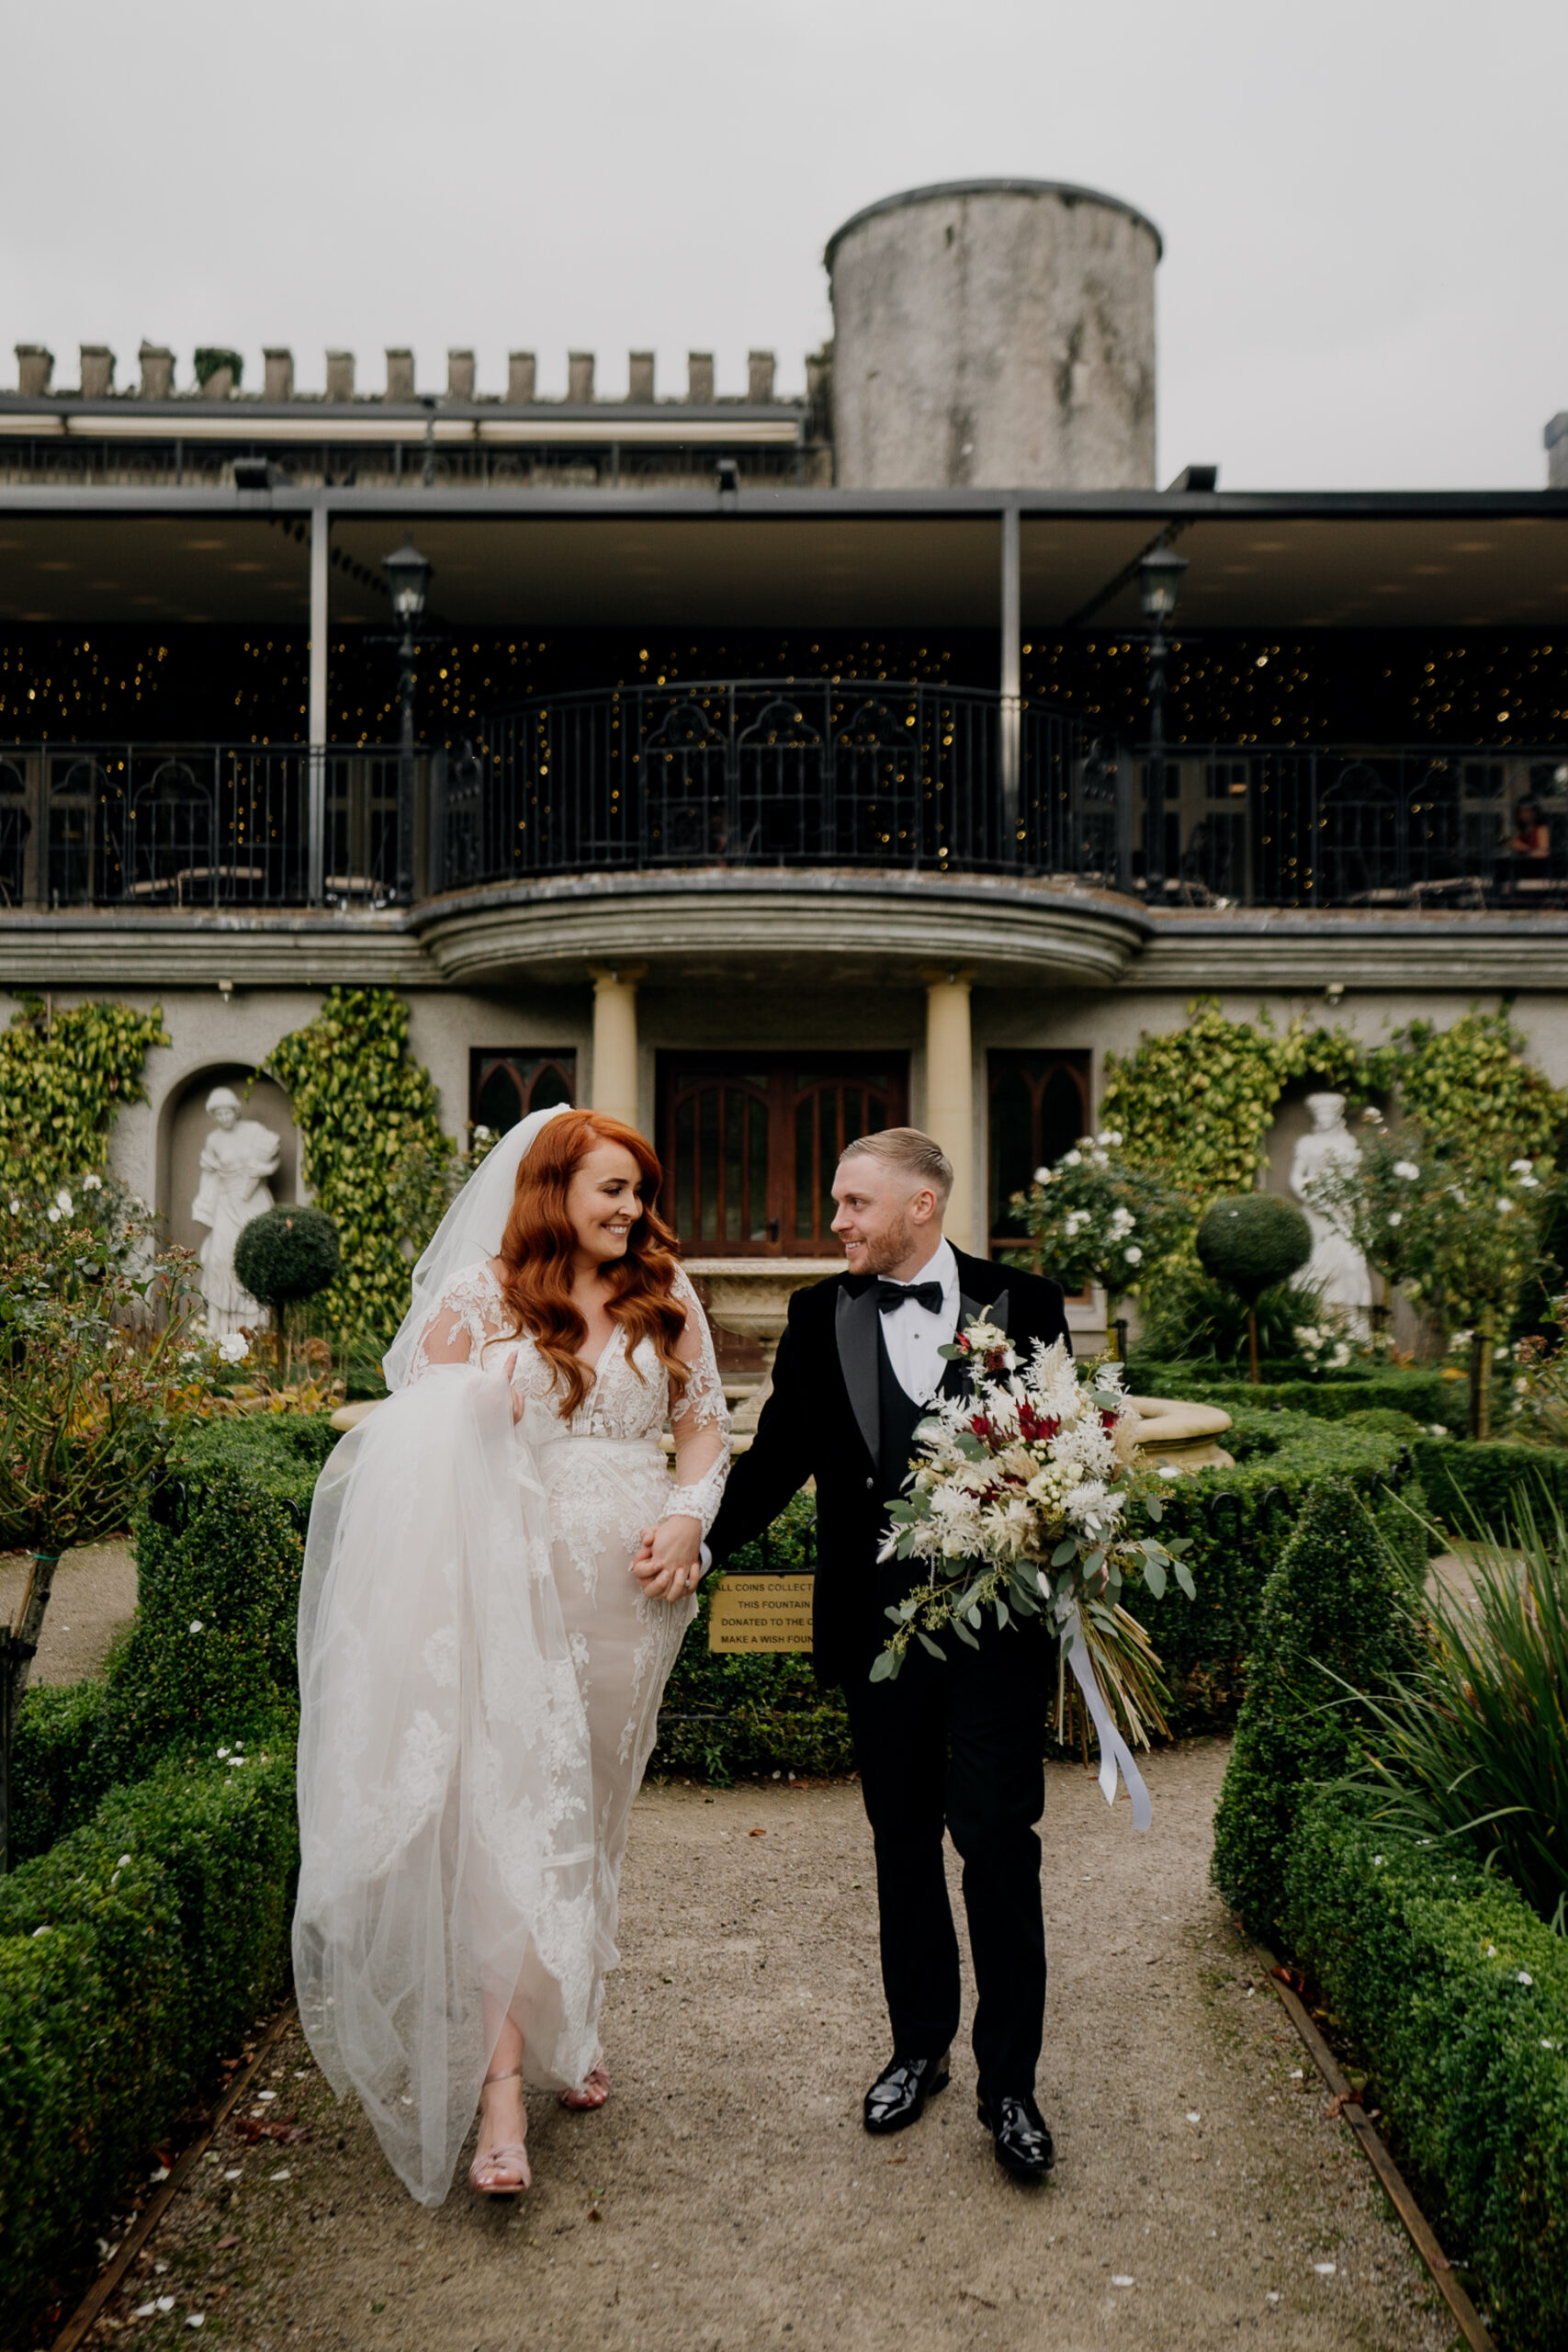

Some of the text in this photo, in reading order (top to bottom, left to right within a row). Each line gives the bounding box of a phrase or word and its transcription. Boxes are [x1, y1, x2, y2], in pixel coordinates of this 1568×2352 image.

[716, 1584, 733, 1592] ALL
[735, 1584, 765, 1592] COINS
[739, 1600, 810, 1609] THIS FOUNTAIN
[721, 1618, 768, 1626] DONATED
[771, 1618, 784, 1626] TO
[786, 1618, 805, 1626] THE
[721, 1635, 749, 1644] MAKE
[751, 1635, 758, 1644] A
[761, 1635, 784, 1644] WISH
